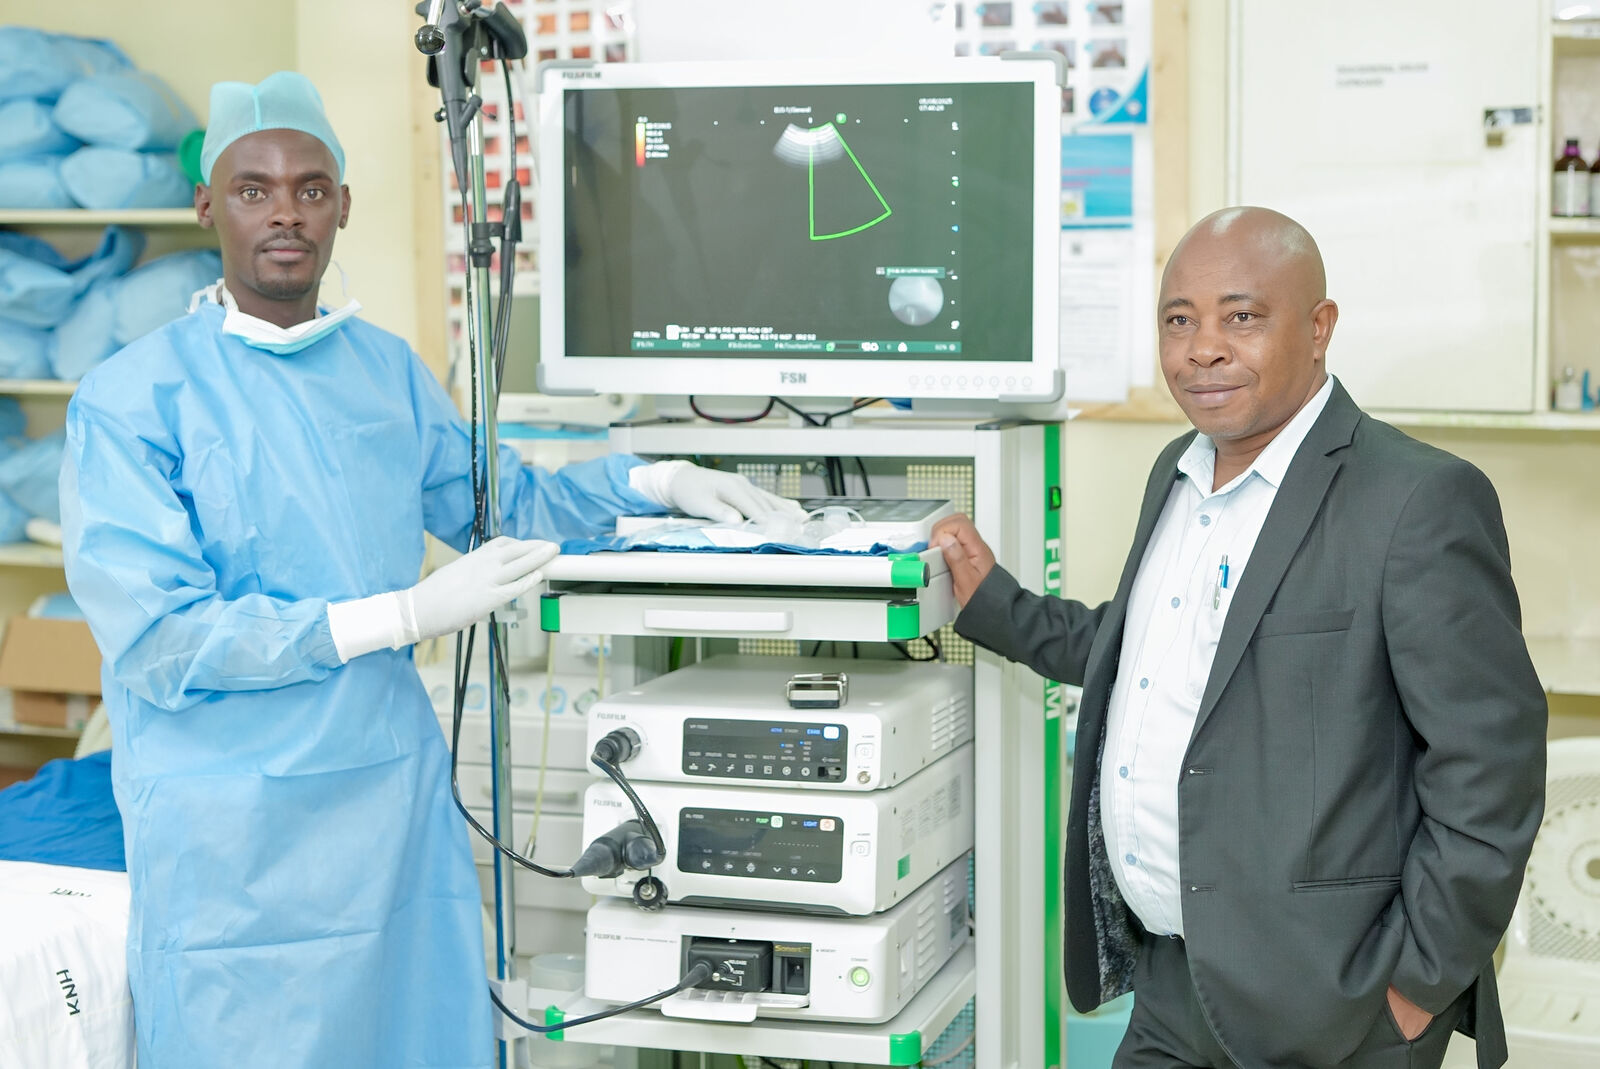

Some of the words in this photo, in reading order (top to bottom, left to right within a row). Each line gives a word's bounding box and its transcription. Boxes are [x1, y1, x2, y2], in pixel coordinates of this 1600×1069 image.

[597, 712, 626, 721] FUJIFILM
[593, 799, 622, 808] FUJIFILM
[593, 932, 621, 941] FUJIFILM
[56, 969, 80, 1016] KNH
